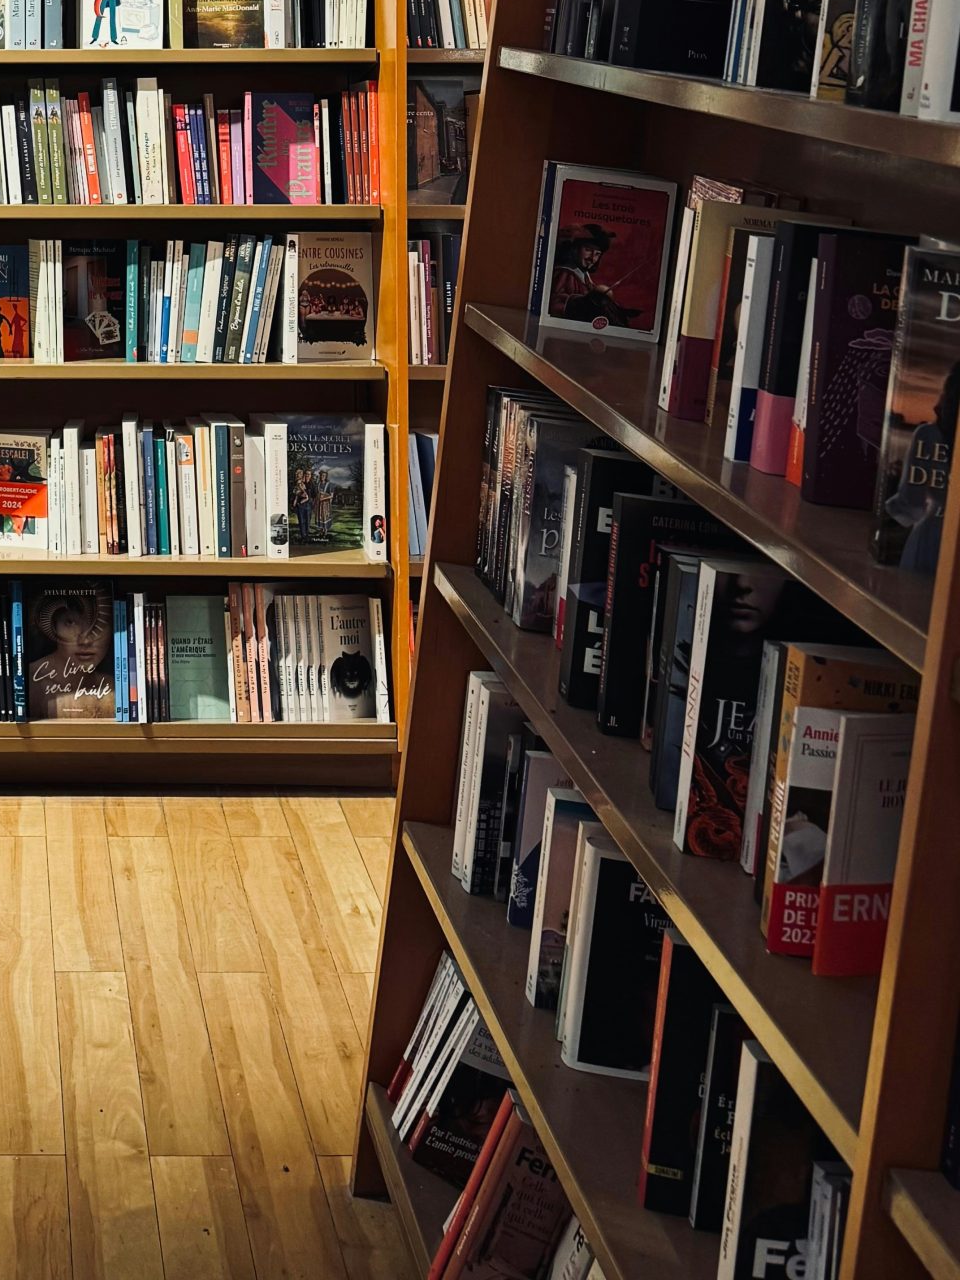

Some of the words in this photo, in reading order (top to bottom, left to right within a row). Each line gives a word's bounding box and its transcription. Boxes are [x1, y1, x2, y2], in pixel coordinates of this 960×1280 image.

[221, 3, 260, 12] MacDonald
[908, 42, 923, 69] MA
[591, 198, 610, 211] Les
[611, 200, 636, 214] trois
[573, 209, 652, 227] mousquetaires
[325, 247, 364, 259] COUSINES
[288, 433, 308, 442] DANS
[308, 434, 320, 442] LE
[287, 442, 308, 453] DES
[309, 441, 353, 454] VOÛTES
[0, 486, 38, 495] ROBERT-CLICHE
[1, 500, 23, 509] 2024
[44, 588, 68, 596] SYLVIE
[329, 615, 366, 631] L'autre
[191, 636, 214, 645] J'ÉTAIS
[339, 633, 361, 646] moi
[171, 644, 207, 654] L'AMÉRIQUE
[32, 661, 57, 682] Ce
[62, 657, 96, 676] livre
[44, 681, 71, 695] sera
[74, 676, 112, 700] brûlé
[802, 724, 839, 743] Annie
[800, 742, 836, 759] Passio
[832, 893, 890, 922] ERN
[783, 909, 806, 926] DE
[425, 1135, 455, 1155] L'amie
[430, 1125, 444, 1138] Par
[445, 1130, 478, 1151] l'autrice
